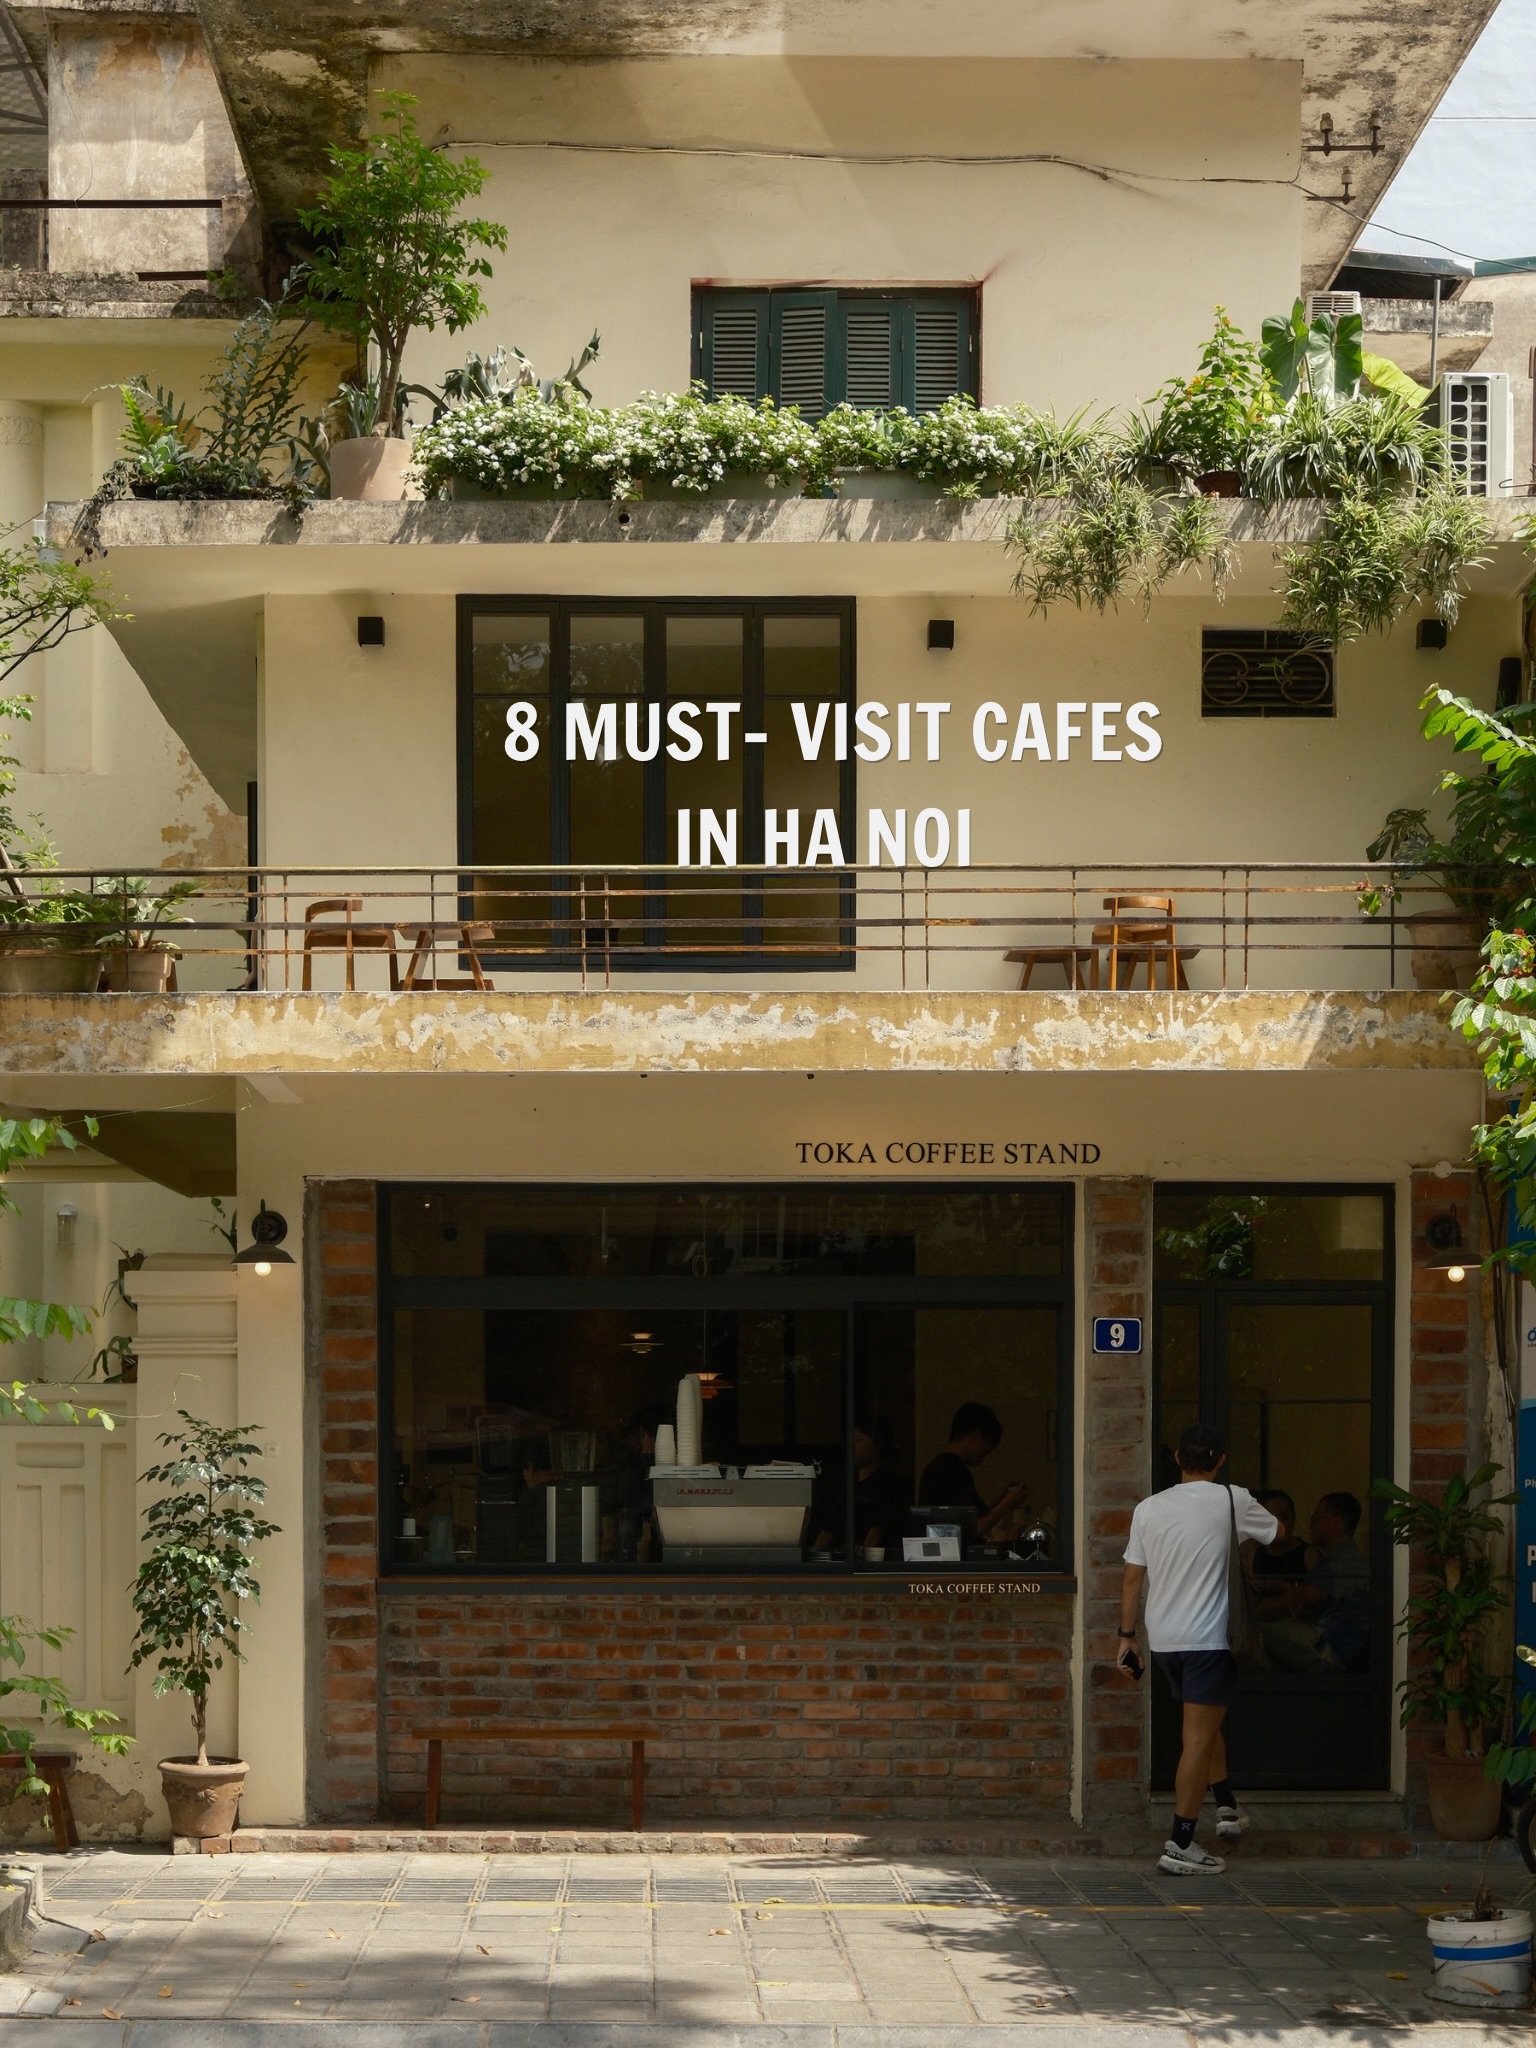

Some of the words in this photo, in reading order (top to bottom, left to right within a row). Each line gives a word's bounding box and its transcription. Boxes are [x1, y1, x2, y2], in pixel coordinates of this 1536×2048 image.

[795, 1142, 877, 1164] TOKA
[885, 1142, 995, 1164] COFFEE
[1004, 1142, 1101, 1164] STAND
[1110, 1323, 1125, 1348] 9
[909, 1583, 944, 1594] TOKA
[947, 1583, 995, 1594] COFFEE
[998, 1583, 1041, 1594] STAND
